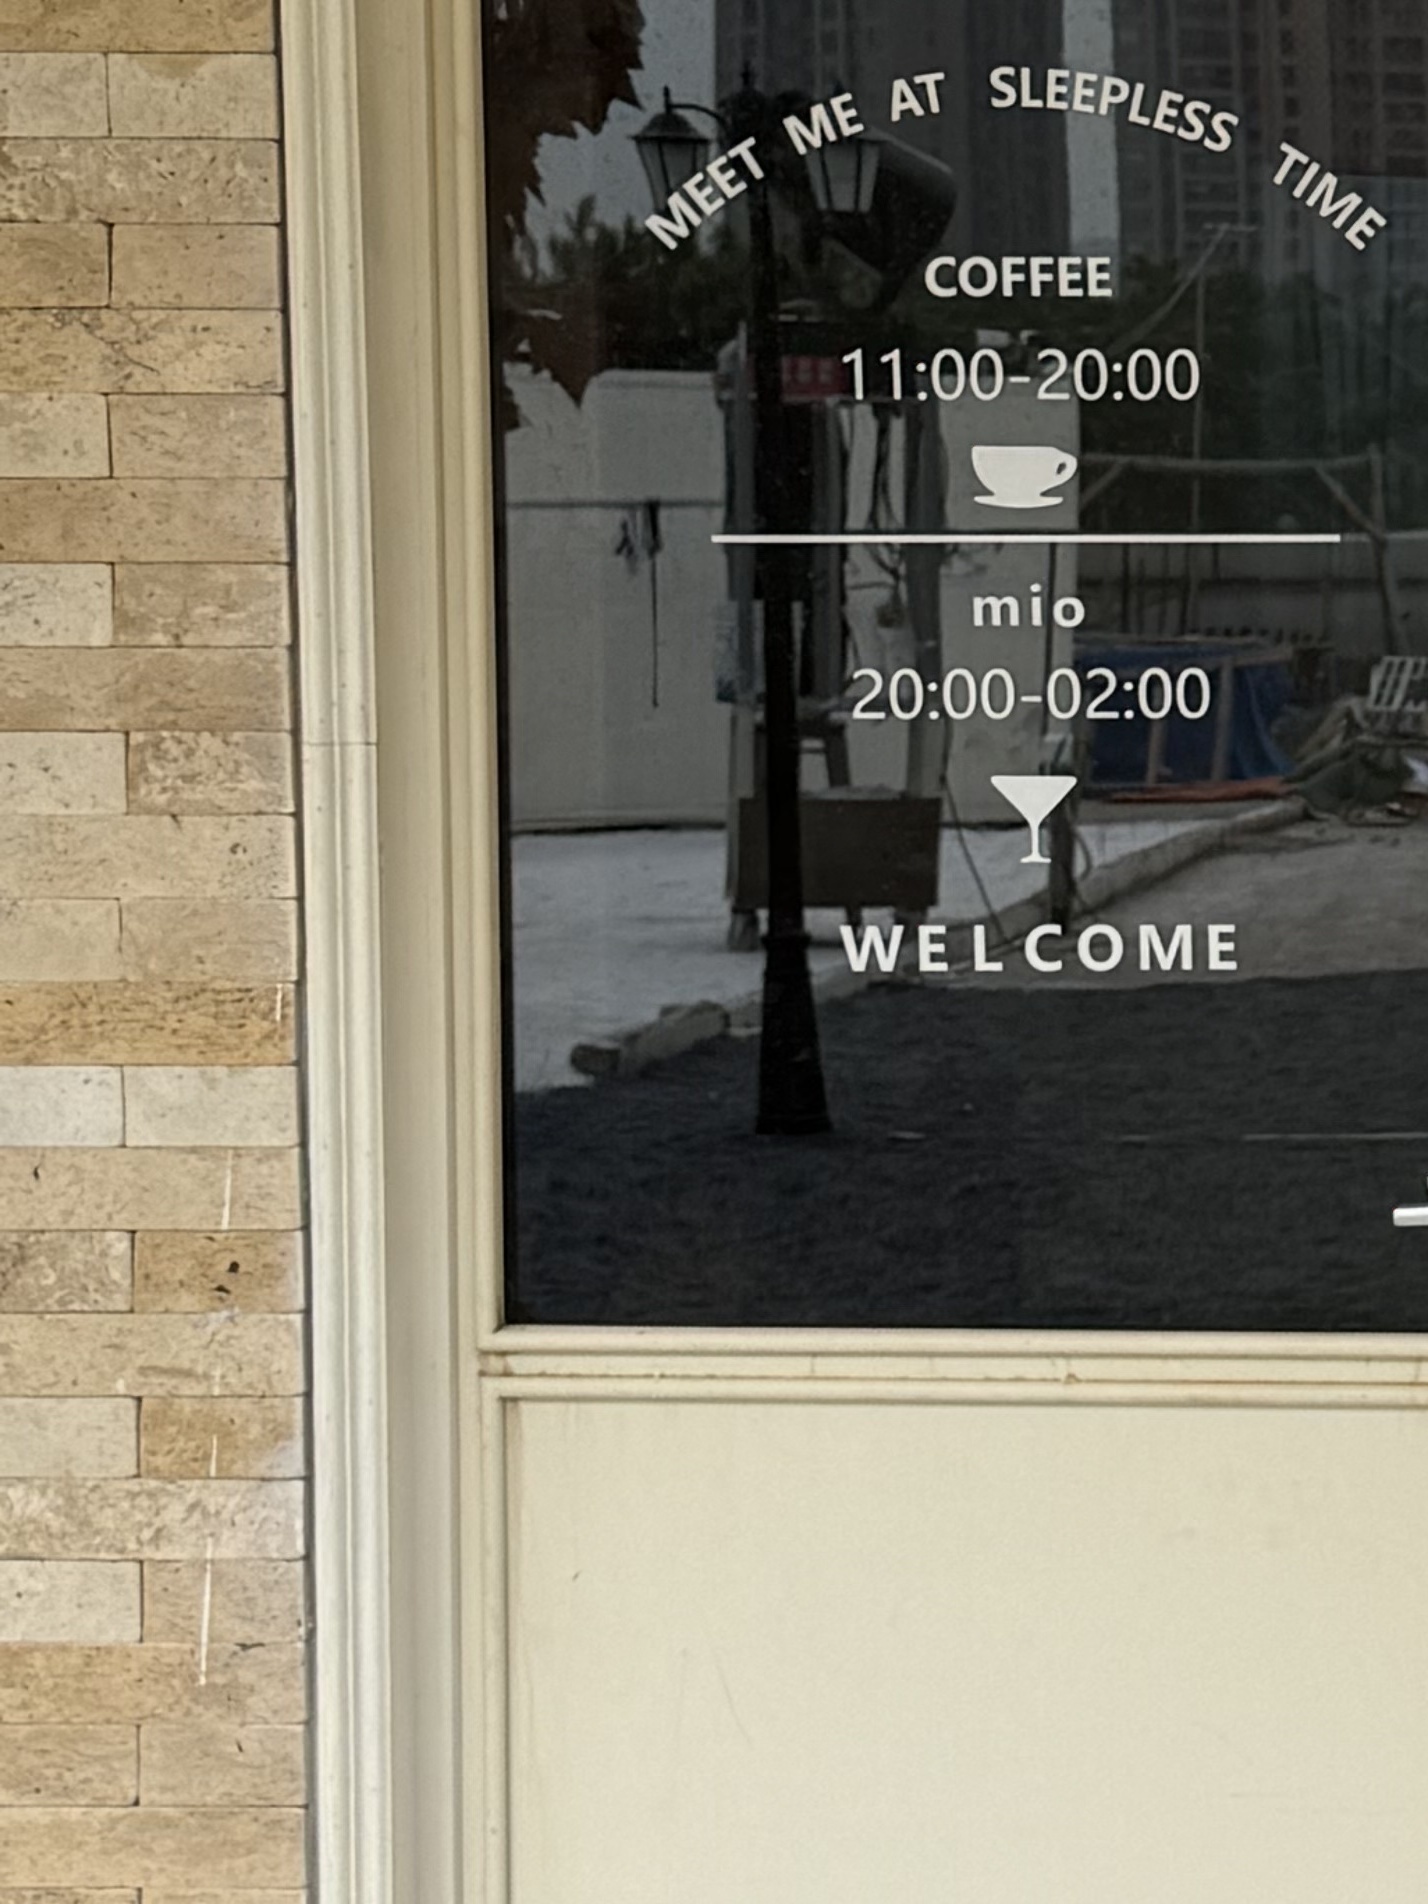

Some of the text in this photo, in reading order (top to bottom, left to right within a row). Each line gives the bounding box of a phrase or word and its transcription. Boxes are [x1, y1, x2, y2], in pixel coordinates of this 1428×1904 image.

[644, 65, 1388, 252] MEET ME AT SLEEPLESS TIME
[924, 255, 1114, 298] COFFEE
[841, 347, 1202, 402] 11:00-20:00
[972, 582, 1086, 629] mio
[851, 666, 1212, 721] 20:00-02:00
[838, 922, 1241, 974] WELCOME
